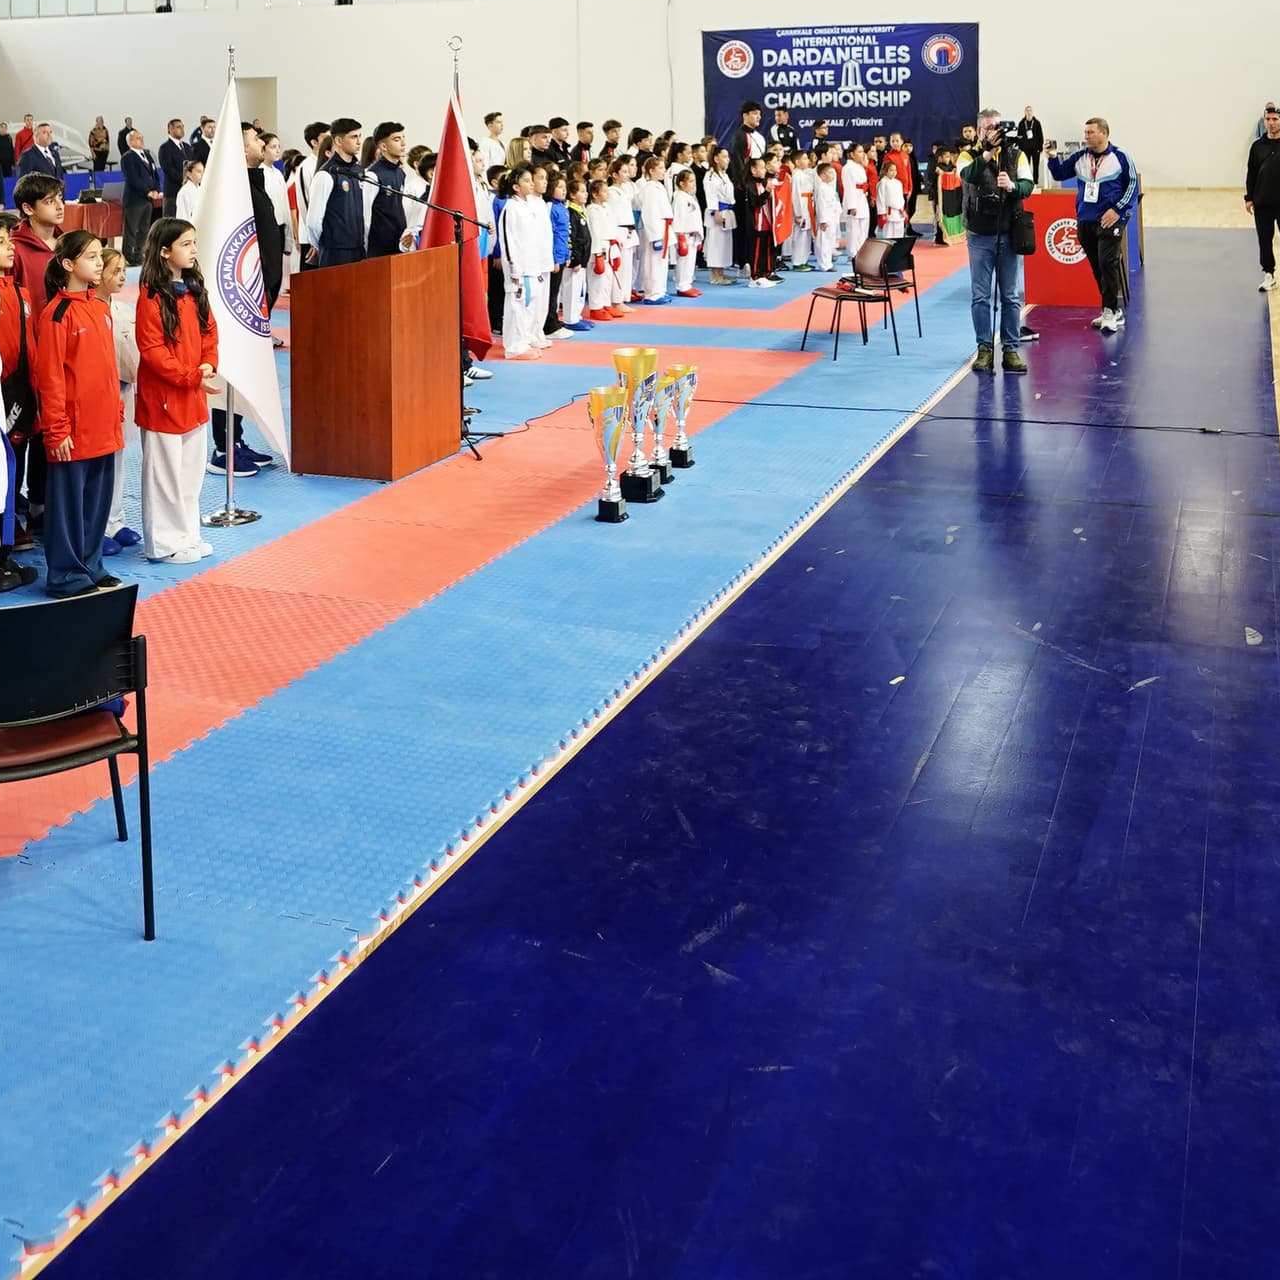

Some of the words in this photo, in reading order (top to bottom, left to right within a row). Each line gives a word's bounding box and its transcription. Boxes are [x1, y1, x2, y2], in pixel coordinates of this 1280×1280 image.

[859, 25, 895, 34] UNIVERSITY
[792, 35, 879, 47] INTERNATIONAL
[762, 45, 911, 67] DARDANELLES
[763, 70, 835, 88] KARATE
[866, 67, 911, 85] CUP
[764, 90, 911, 109] CHAMPIONSHIP
[851, 117, 883, 127] TÜRKİYE
[223, 225, 254, 291] ÇANAKKALE
[231, 298, 254, 326] 1992
